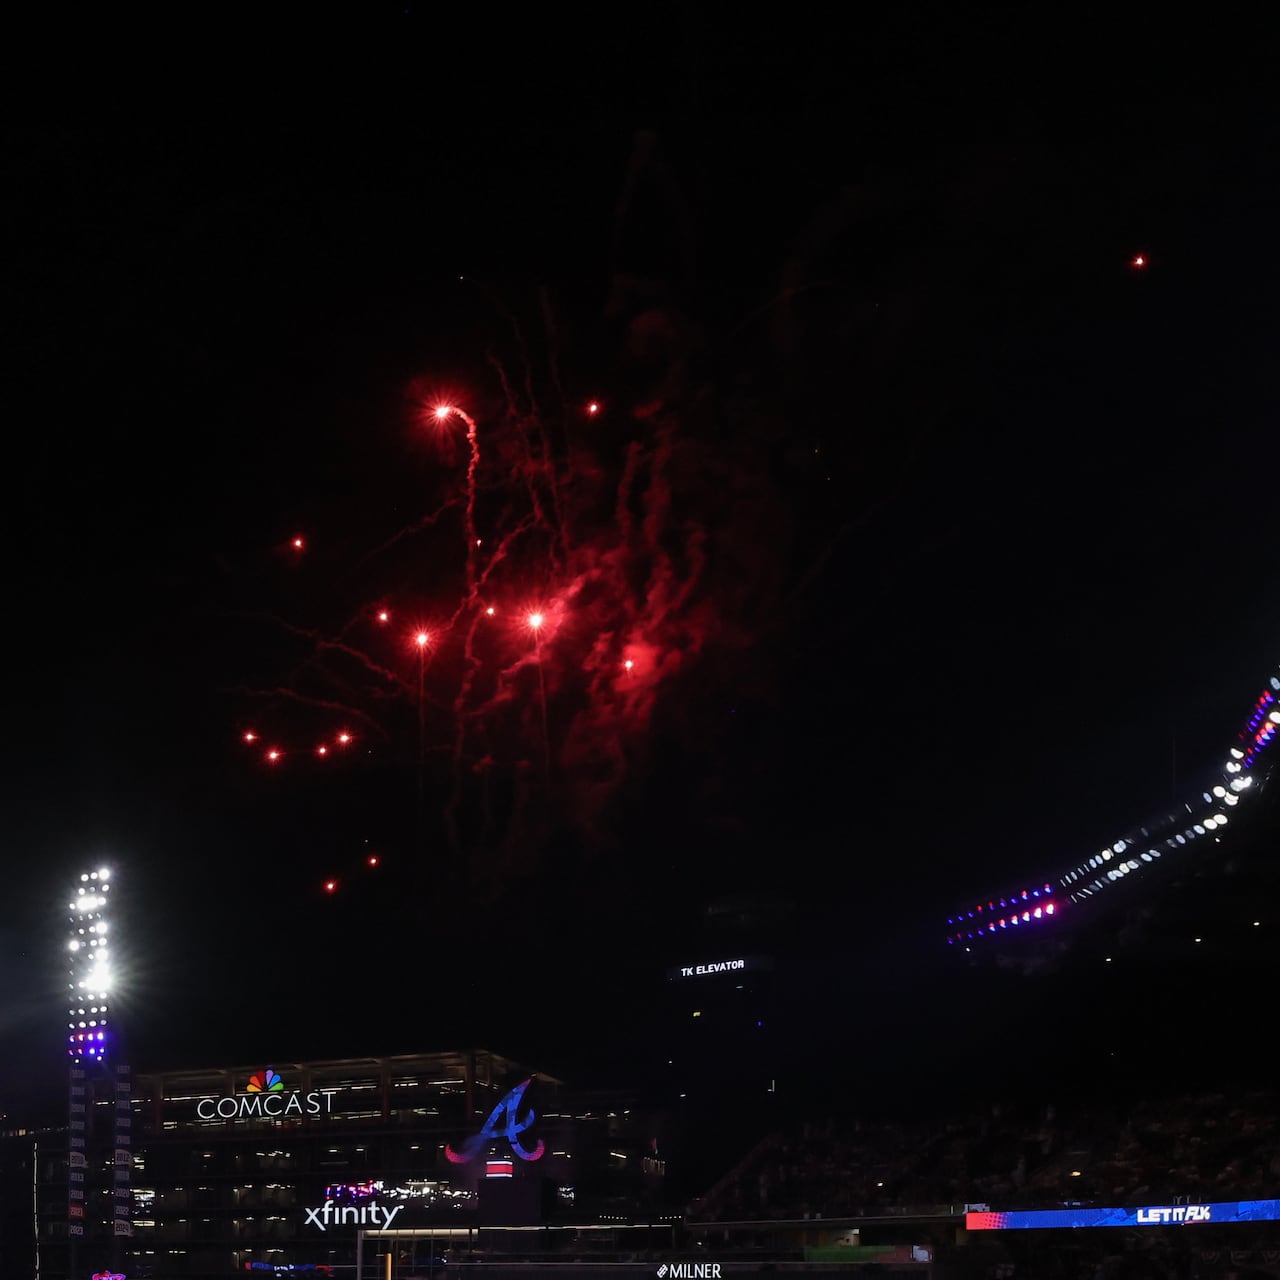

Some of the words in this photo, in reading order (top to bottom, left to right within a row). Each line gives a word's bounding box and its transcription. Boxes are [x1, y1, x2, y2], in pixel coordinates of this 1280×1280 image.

[681, 968, 694, 976] TK
[696, 960, 744, 974] ELEVATOR
[197, 1091, 337, 1119] COMCAST
[304, 1200, 404, 1231] xfinity
[1137, 1208, 1169, 1223] LET
[1171, 1208, 1185, 1222] IT
[669, 1263, 722, 1279] MILNER
